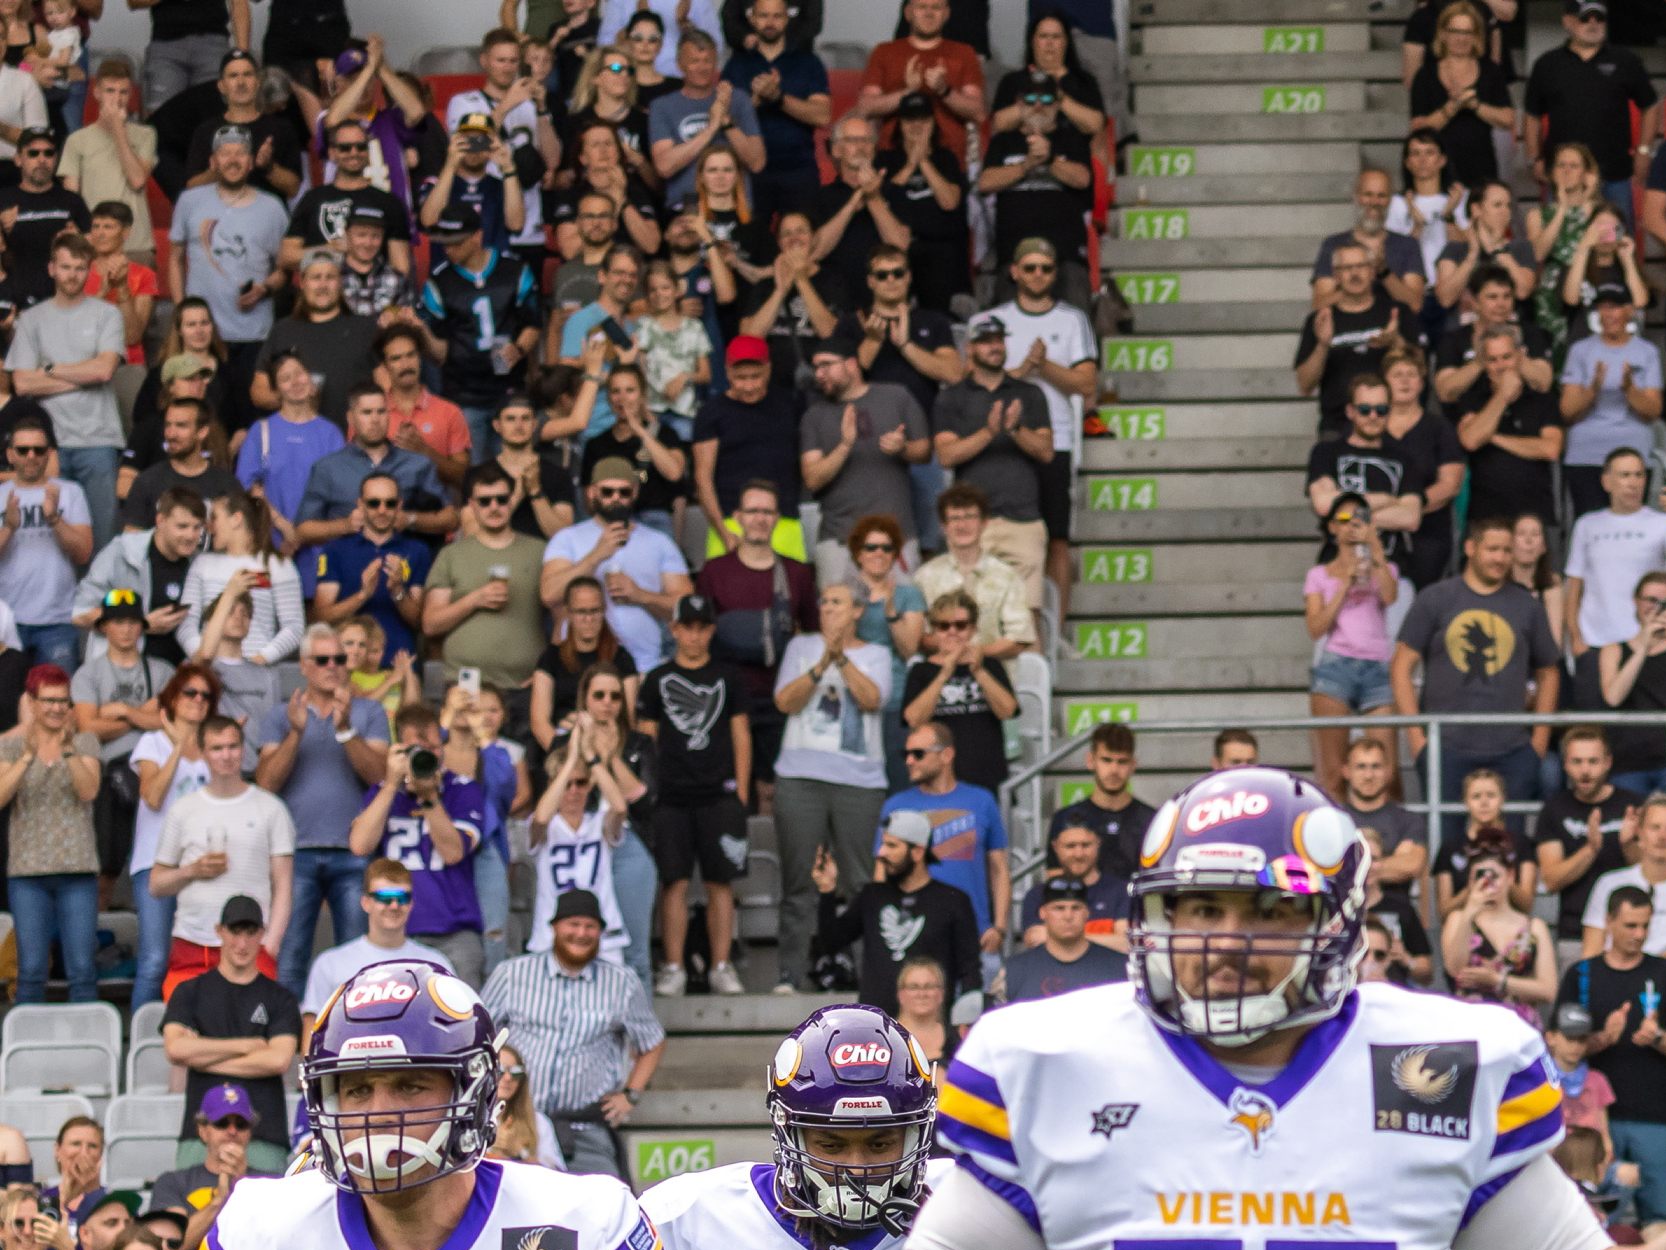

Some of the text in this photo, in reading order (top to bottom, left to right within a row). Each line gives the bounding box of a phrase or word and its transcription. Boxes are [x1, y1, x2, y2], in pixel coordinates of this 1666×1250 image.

[1267, 32, 1319, 53] A21
[1266, 91, 1323, 113] A20
[1136, 153, 1193, 176] A19
[1129, 215, 1186, 239] A18
[474, 295, 496, 351] 1
[1111, 346, 1170, 372] A16
[1093, 483, 1155, 510] A14
[1087, 554, 1148, 582] A13
[1082, 628, 1144, 657] A12
[1187, 792, 1269, 833] Chio
[551, 840, 601, 889] 27
[347, 981, 414, 1010] Chio
[346, 1039, 395, 1050] FORELLE
[834, 1042, 891, 1065] Chio
[842, 1101, 883, 1109] FORELLE
[1375, 1109, 1468, 1137] 28 BLACK
[642, 1146, 711, 1178] A06
[1155, 1192, 1352, 1226] VIENNA
